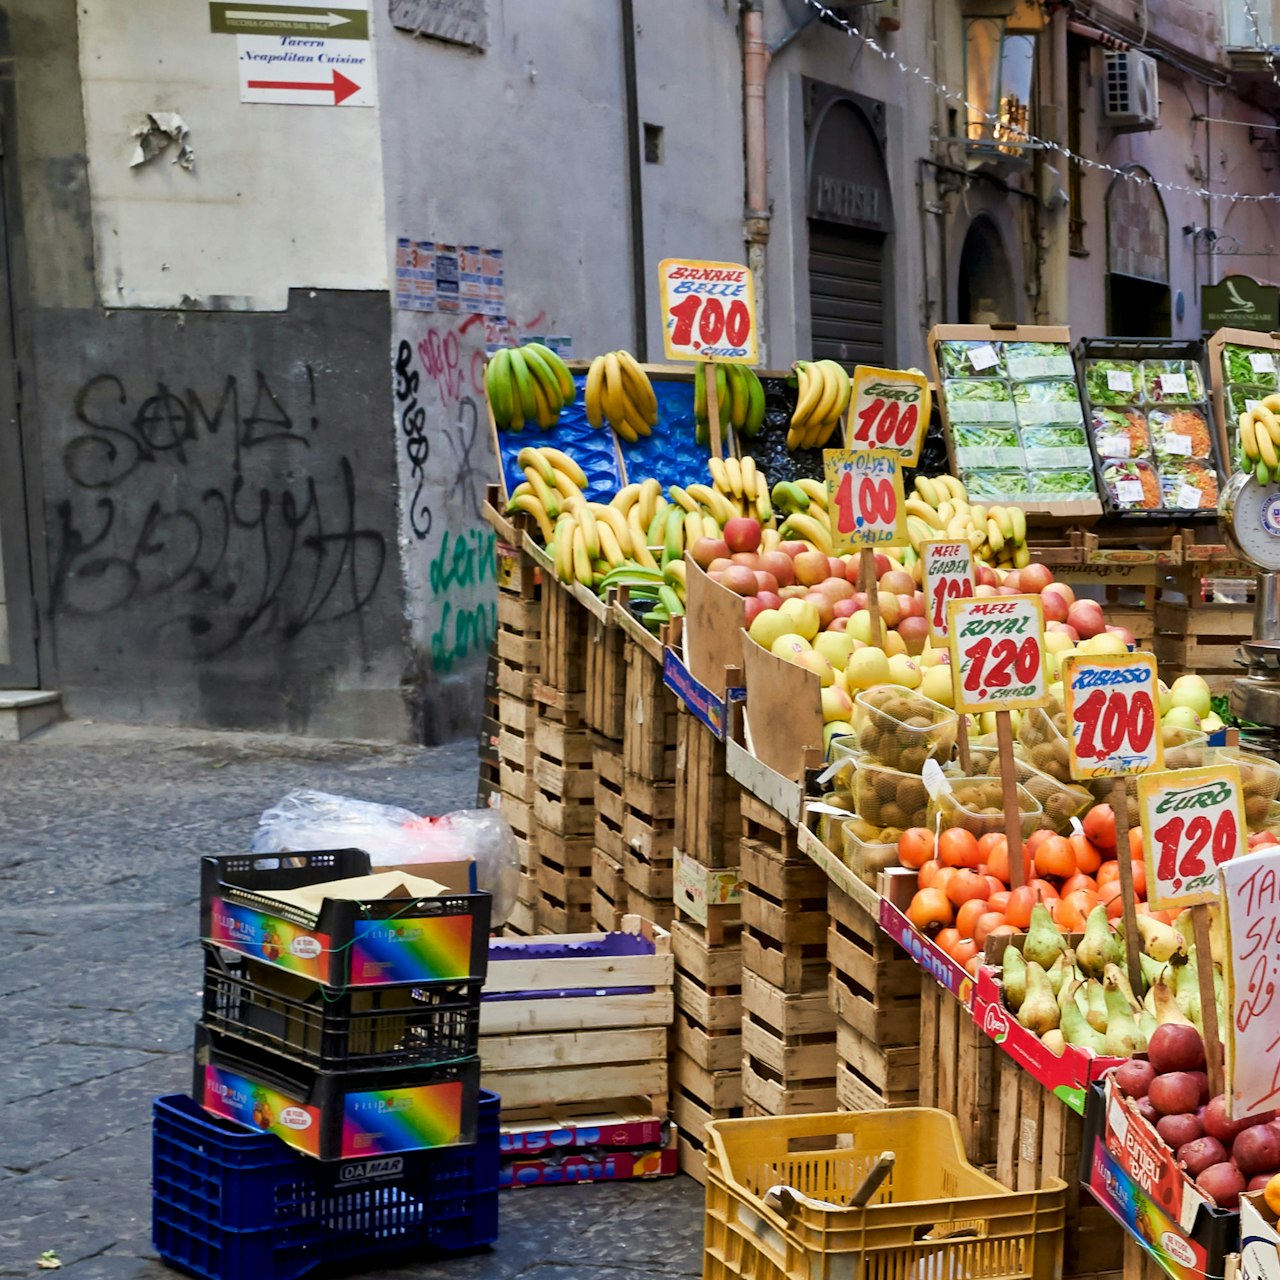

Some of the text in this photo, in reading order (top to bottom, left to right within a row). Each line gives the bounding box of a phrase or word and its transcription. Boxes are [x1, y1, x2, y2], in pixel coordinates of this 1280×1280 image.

[280, 36, 324, 48] Tavern
[240, 50, 365, 64] Neapolitan Cuisine
[668, 267, 746, 282] BANANE
[1054, 565, 1116, 578] Primizi
[960, 616, 1031, 638] ROYAL
[1072, 668, 1151, 690] RIBASSO
[1156, 782, 1232, 814] EURO
